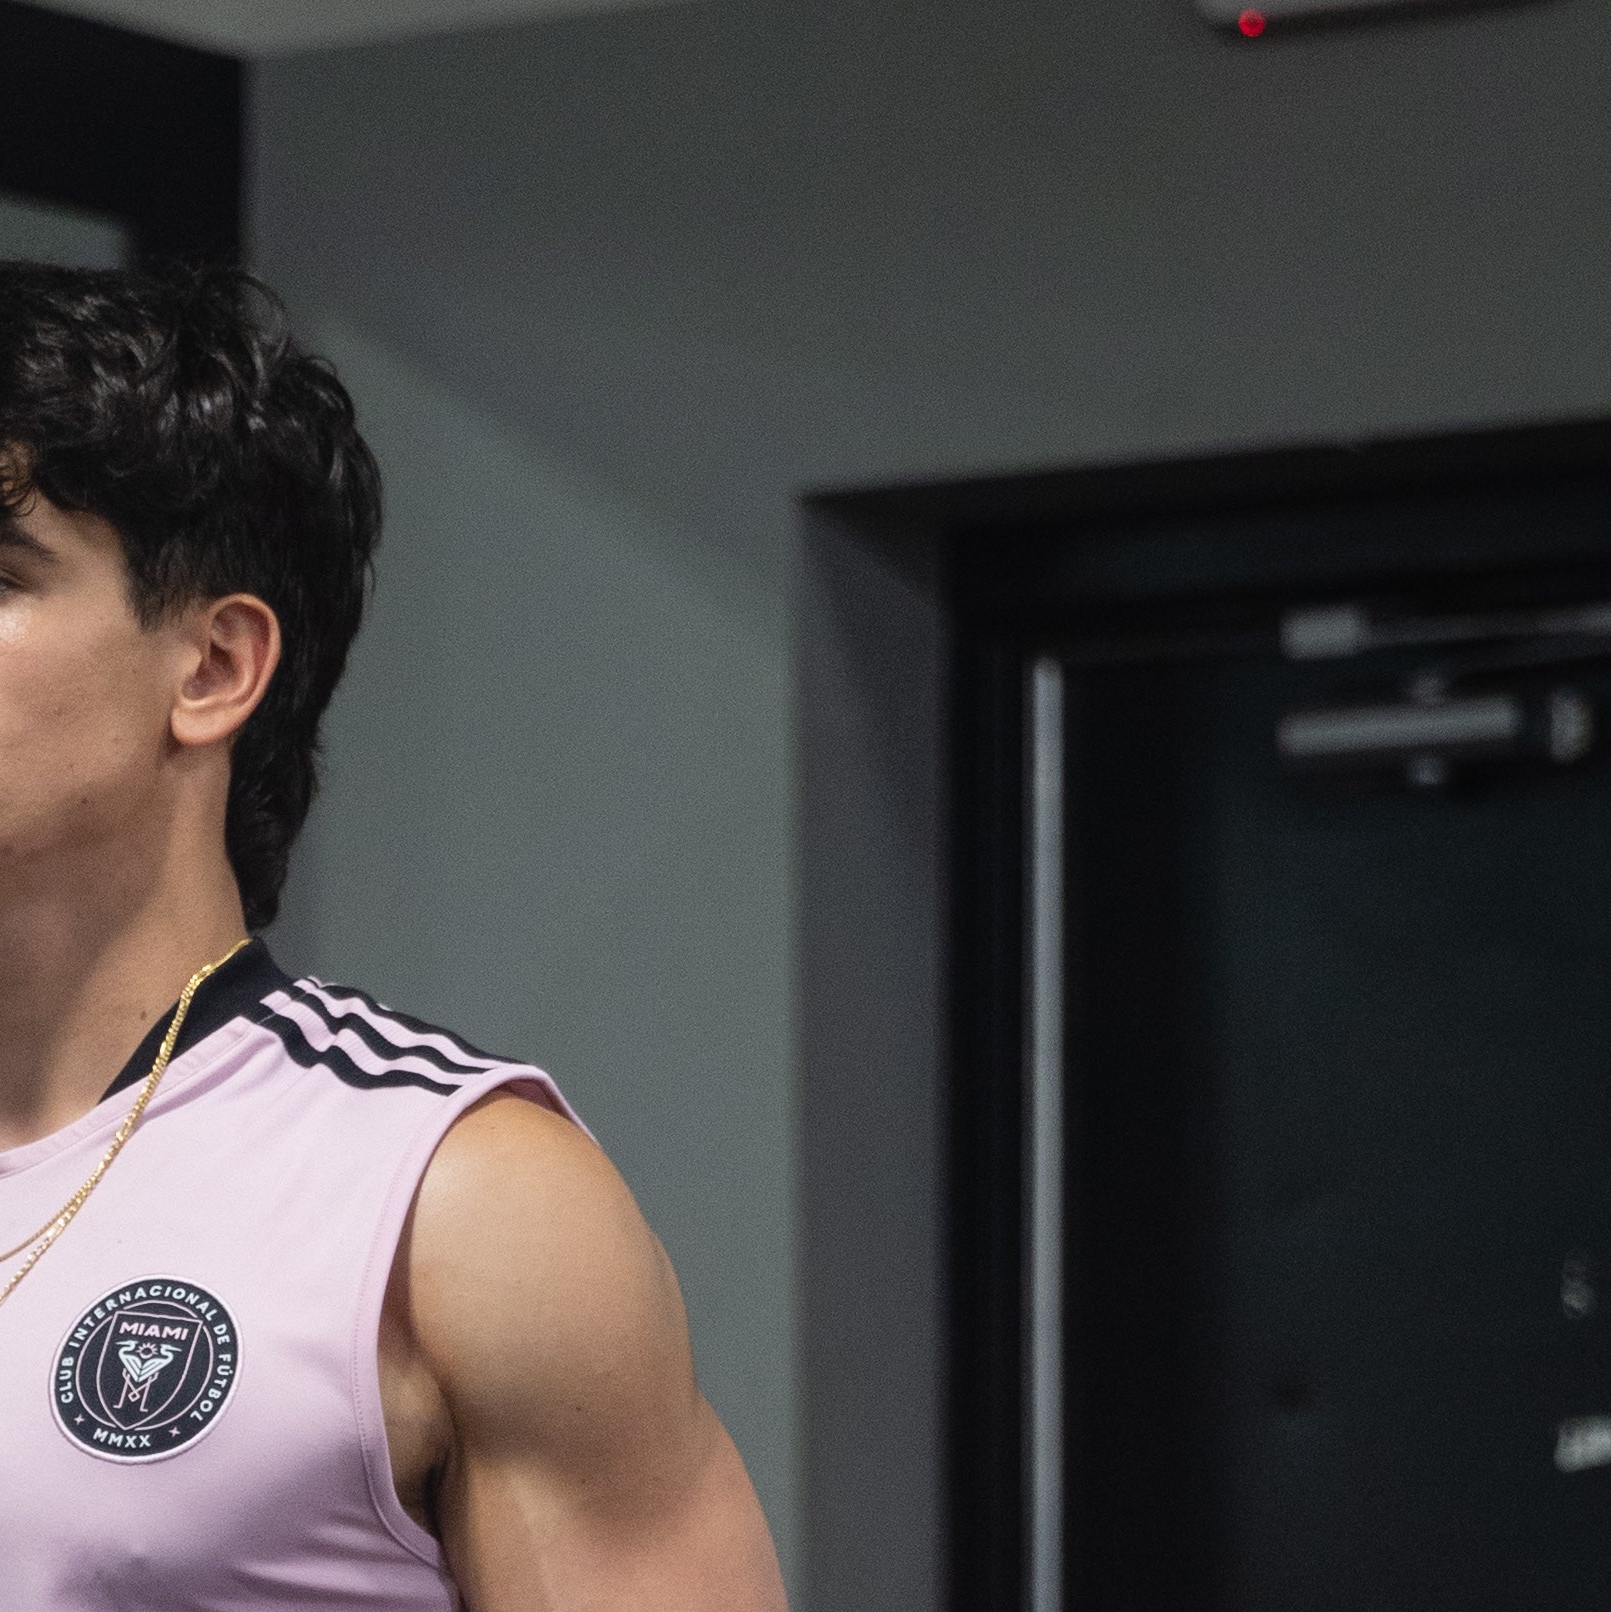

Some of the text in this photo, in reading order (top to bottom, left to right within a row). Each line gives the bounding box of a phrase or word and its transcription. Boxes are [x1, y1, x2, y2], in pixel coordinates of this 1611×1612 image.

[119, 1321, 189, 1341] MIAMI
[59, 1285, 233, 1421] CLUB INTERNACIONAL DE FÚTBOL
[93, 1428, 151, 1448] MMXX
